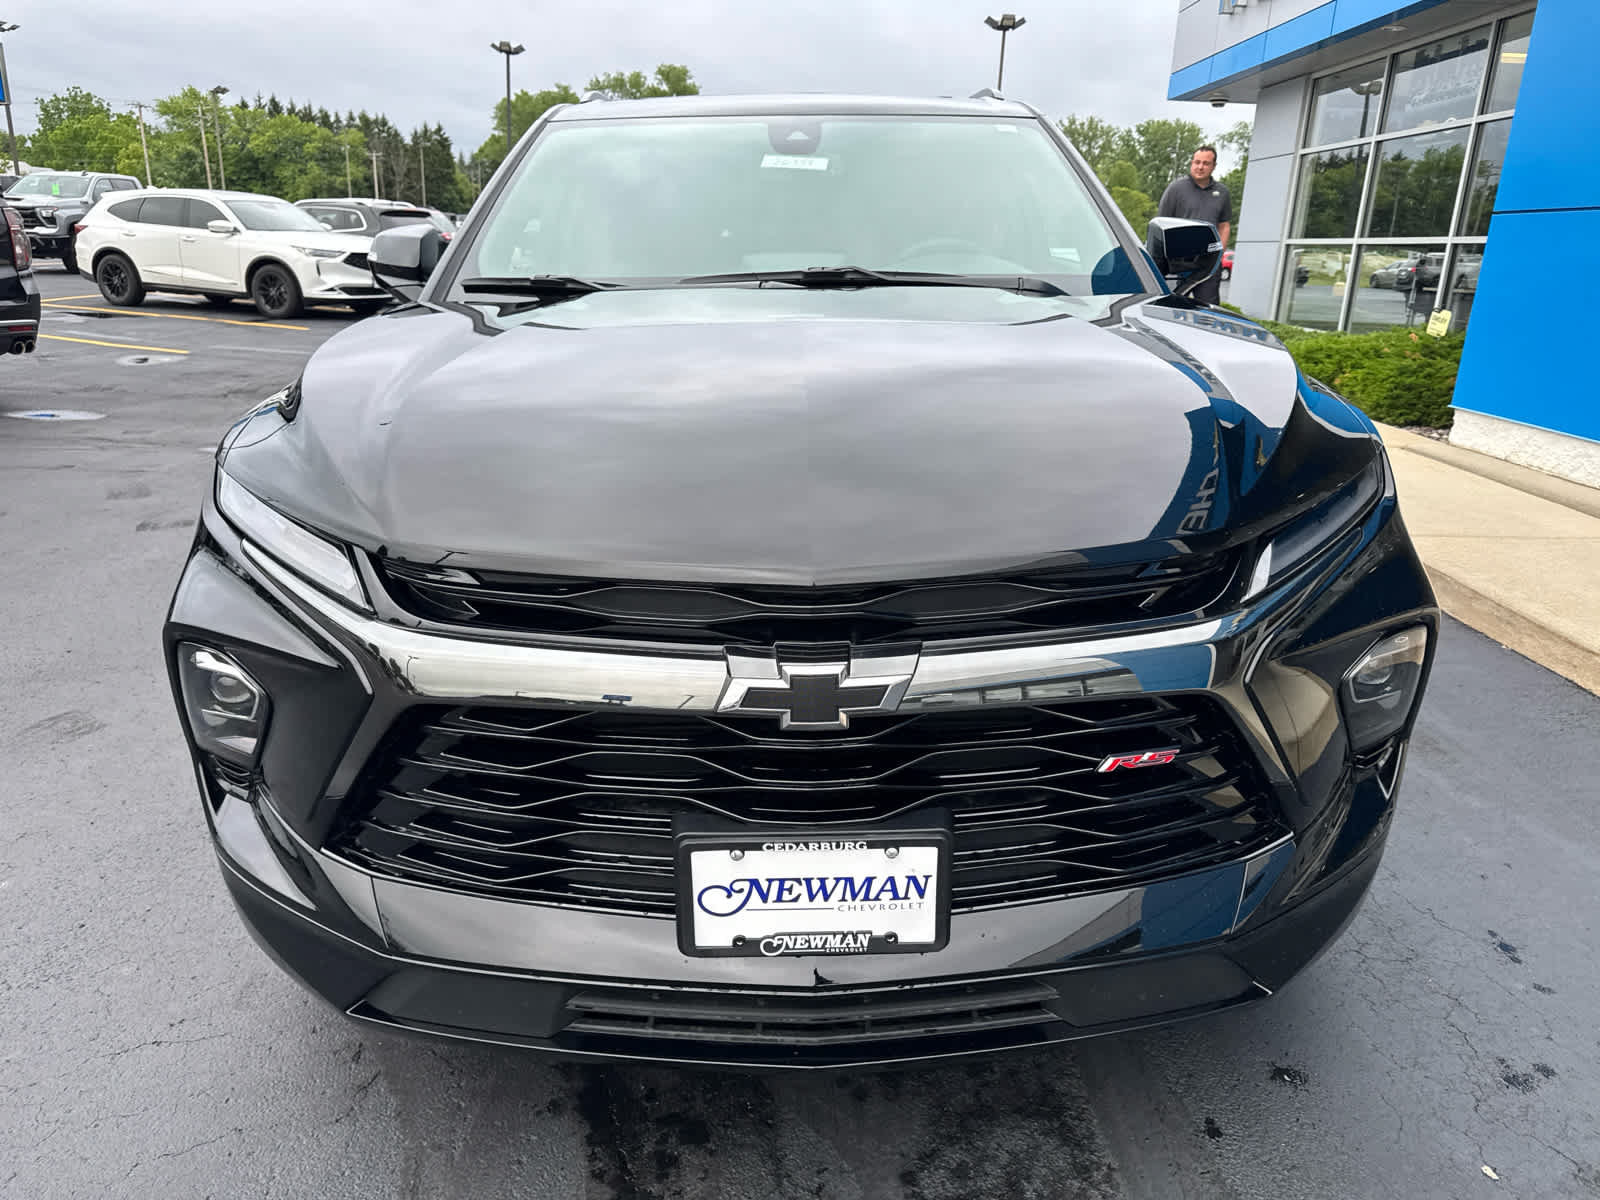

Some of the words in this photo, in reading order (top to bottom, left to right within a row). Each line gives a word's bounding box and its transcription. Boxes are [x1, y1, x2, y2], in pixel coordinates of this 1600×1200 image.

[1097, 748, 1180, 773] RS
[762, 841, 868, 852] CEDARBURG
[697, 874, 932, 917] NEWMAN
[837, 902, 924, 912] CHEVROLET
[760, 933, 871, 956] NEWMAN
